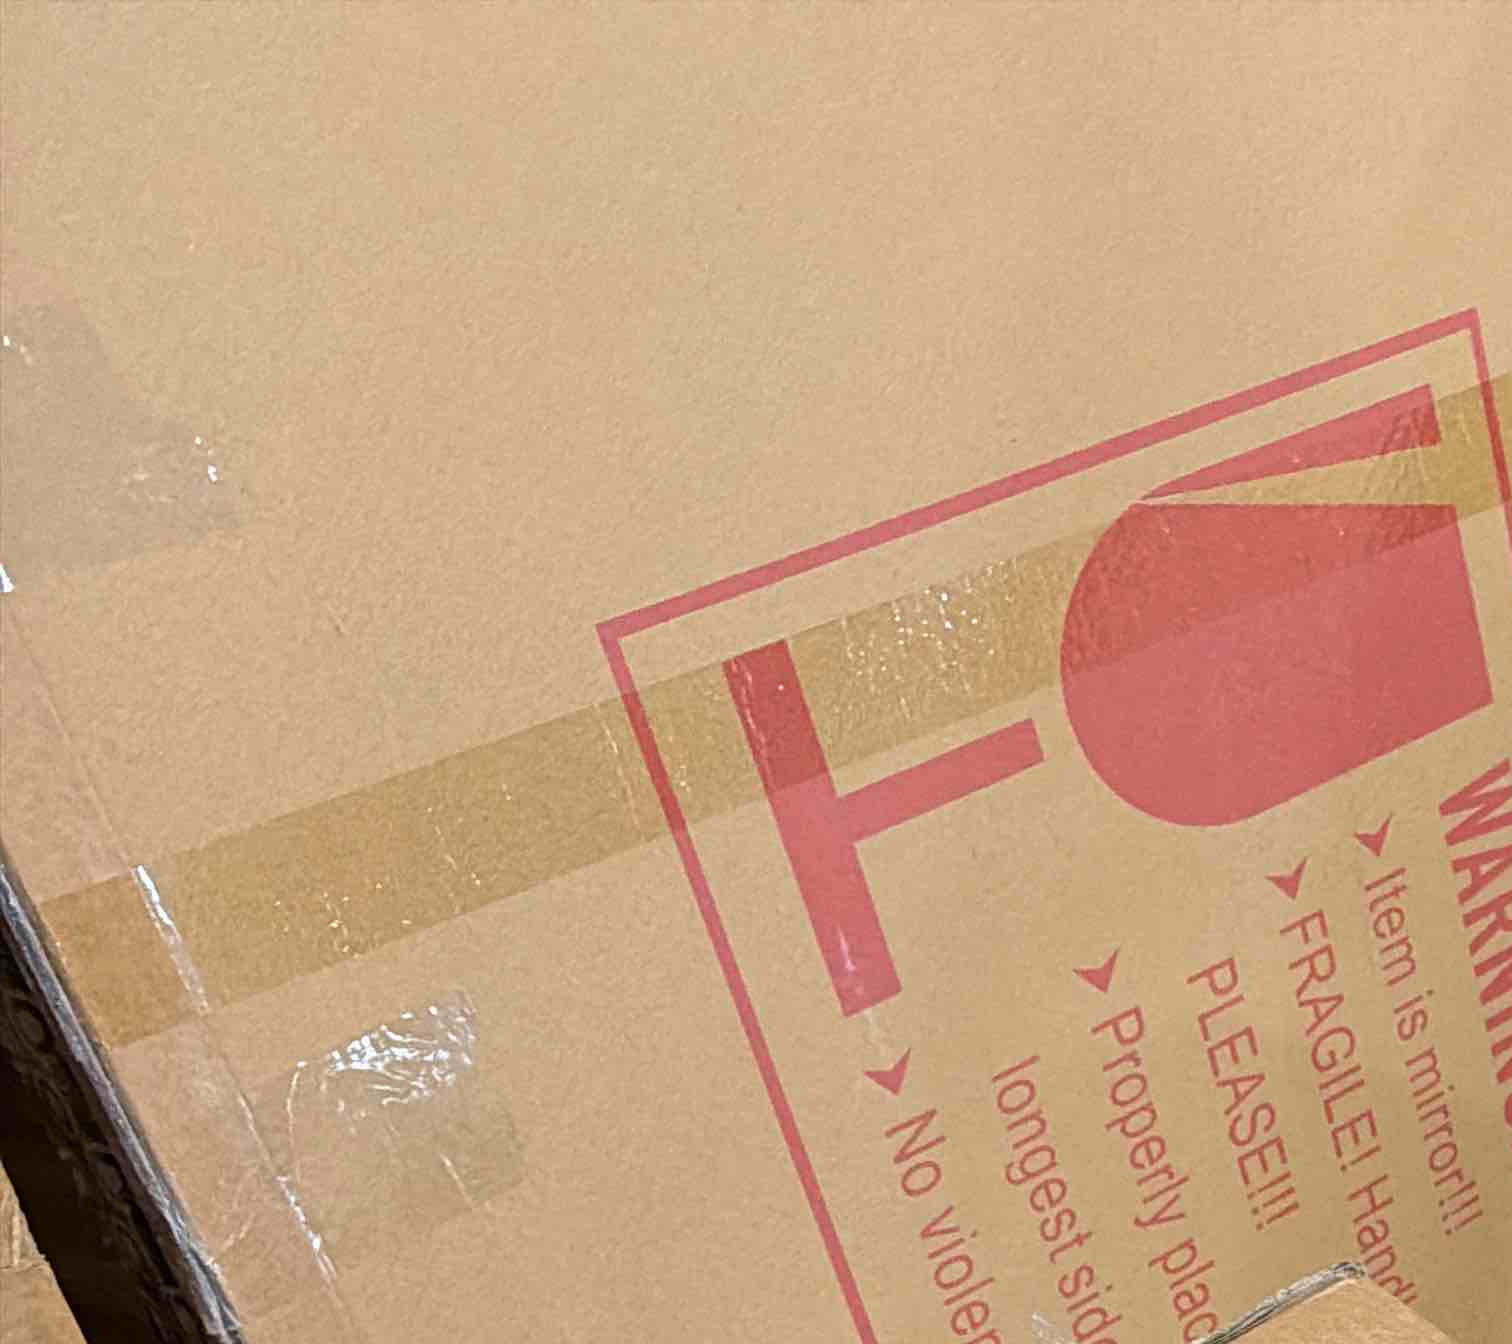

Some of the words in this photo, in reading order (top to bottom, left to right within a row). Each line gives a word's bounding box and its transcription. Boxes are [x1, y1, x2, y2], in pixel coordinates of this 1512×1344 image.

[1364, 867, 1417, 988] Item
[1393, 988, 1434, 1042] is
[1090, 1006, 1190, 1230] Properly
[1185, 957, 1301, 1232] PLEASE!!!
[1280, 909, 1382, 1173] FRAGILE!
[885, 1107, 947, 1199] No
[992, 1055, 1093, 1264] longest
[1405, 1046, 1483, 1237] mirror!!!
